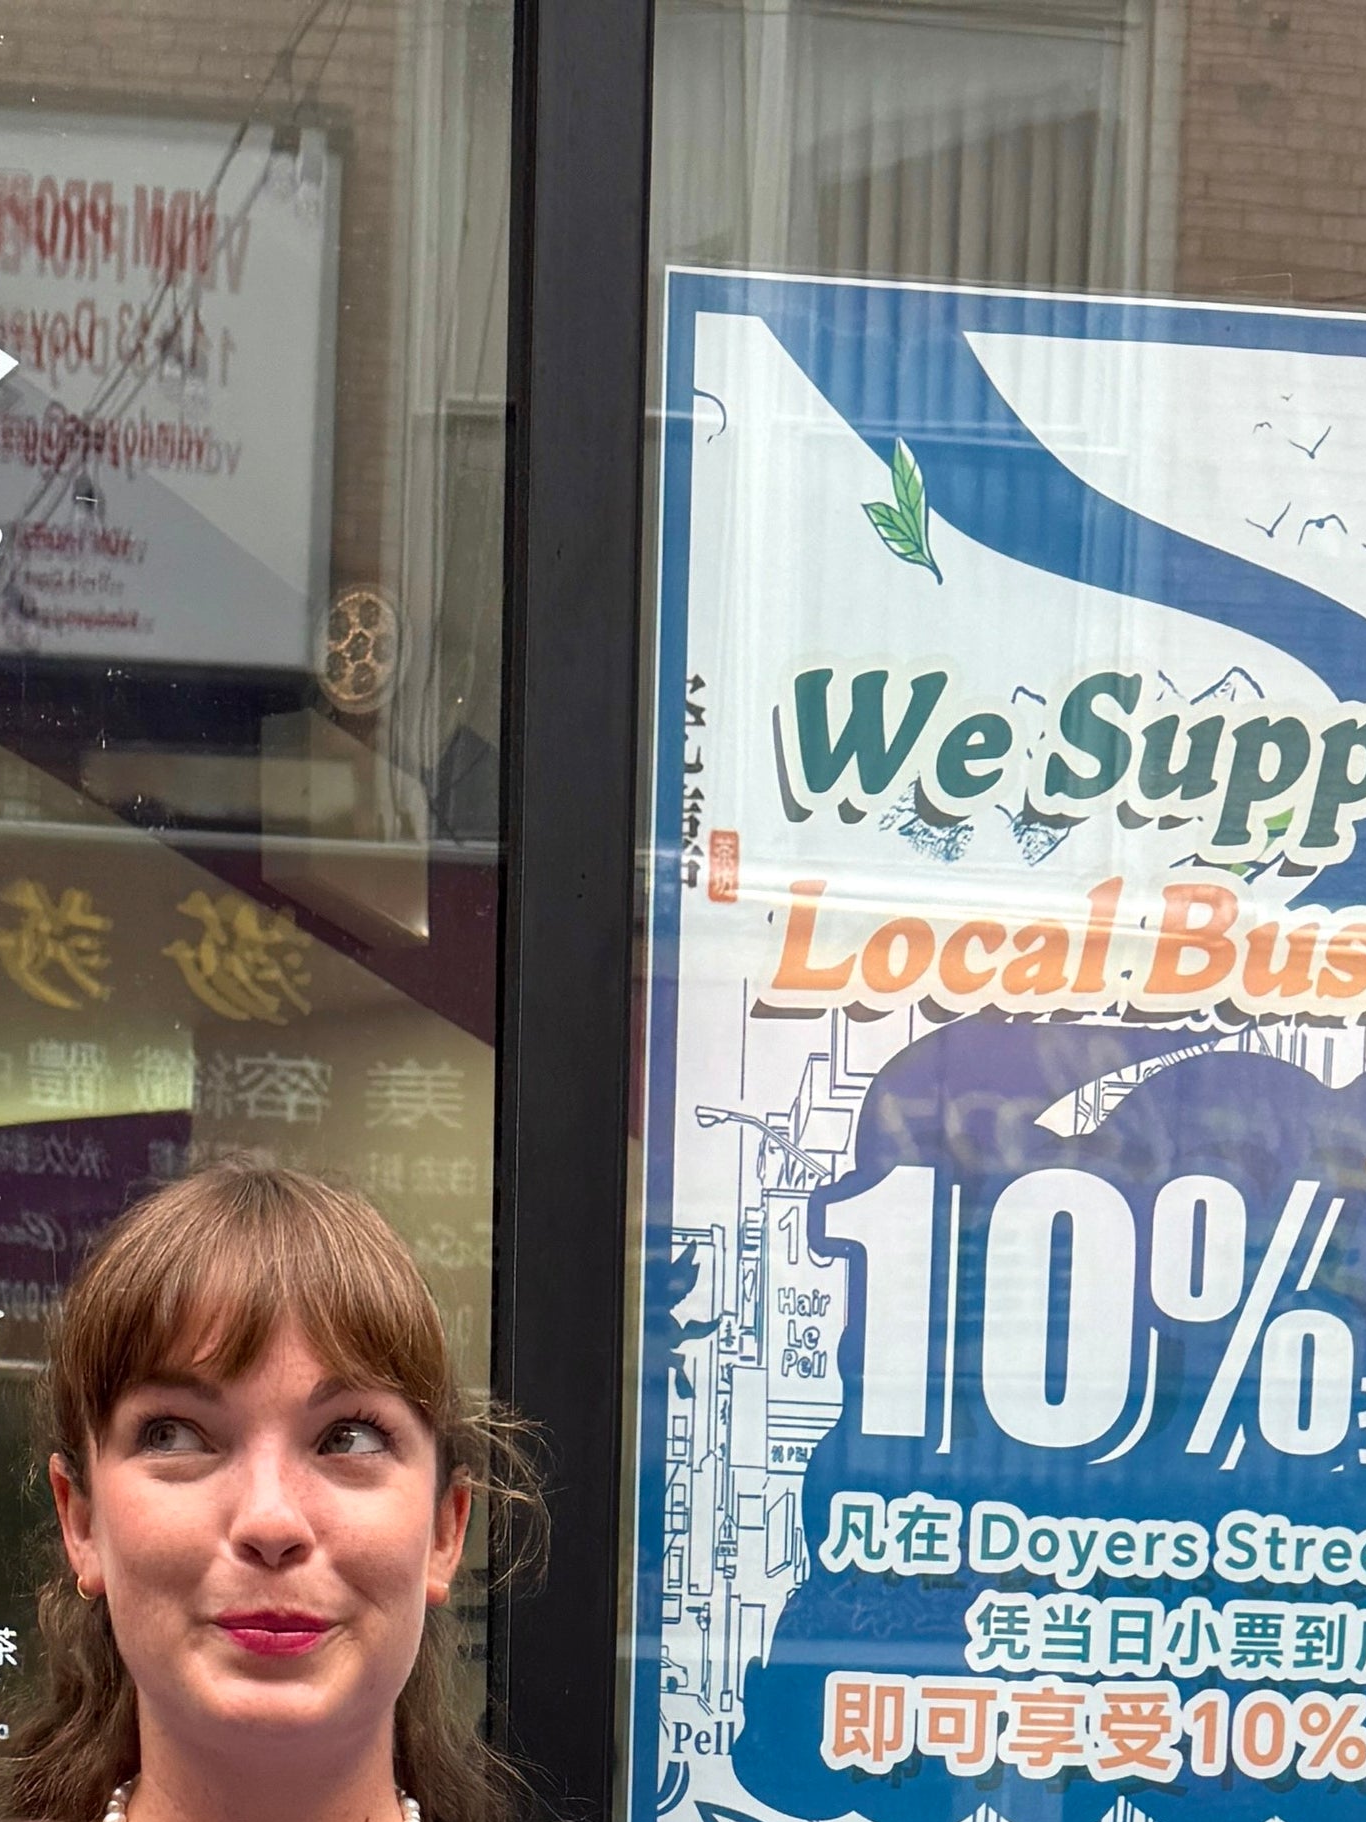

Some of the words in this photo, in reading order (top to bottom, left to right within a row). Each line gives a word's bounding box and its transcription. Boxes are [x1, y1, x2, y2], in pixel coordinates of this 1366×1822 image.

[789, 666, 1015, 799] We
[771, 877, 1135, 999] Local
[777, 1287, 831, 1317] Hair
[820, 1164, 1356, 1459] 10%
[829, 1504, 951, 1566] 凡在
[980, 1518, 1199, 1578] Doyers
[672, 1721, 735, 1756] Pell
